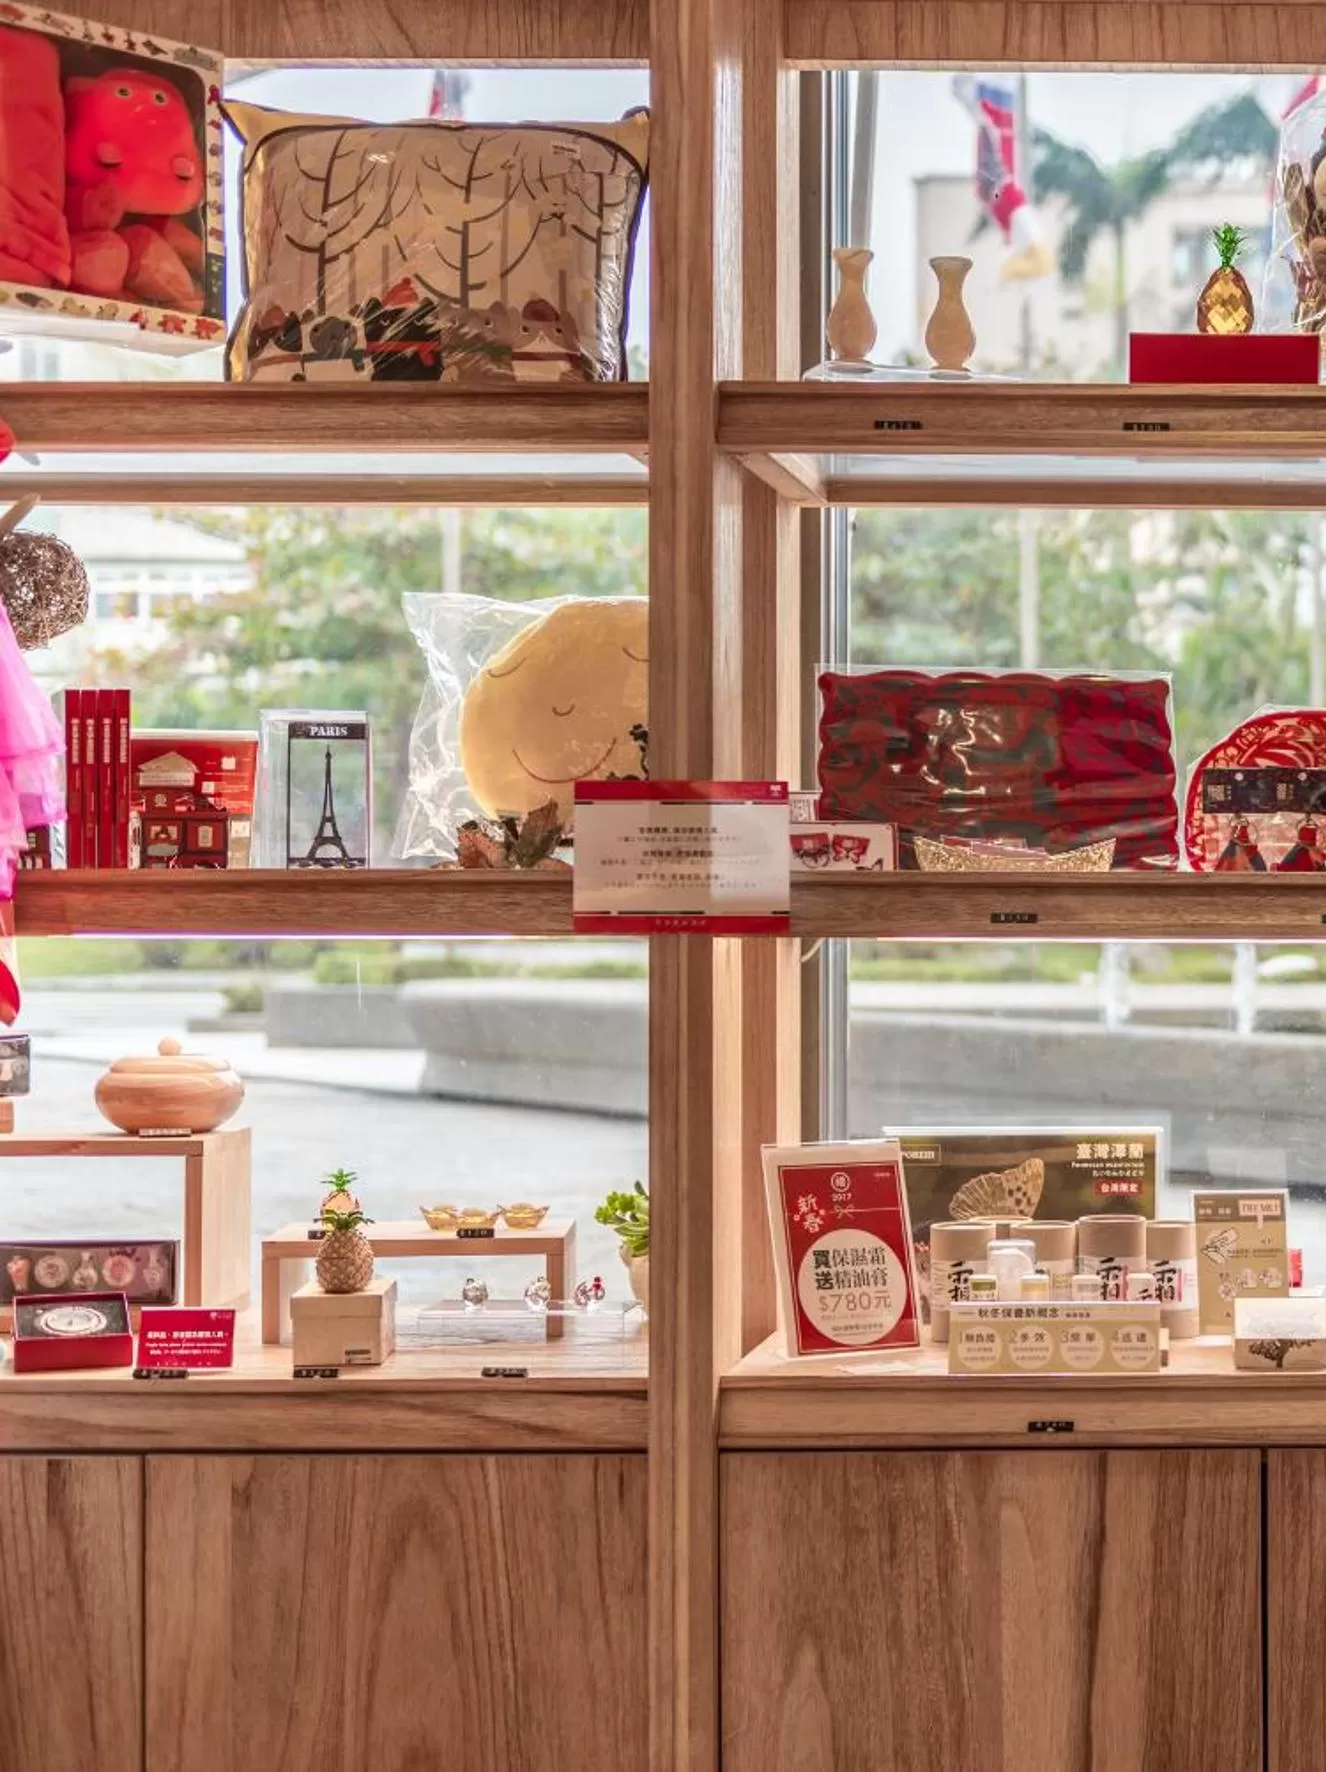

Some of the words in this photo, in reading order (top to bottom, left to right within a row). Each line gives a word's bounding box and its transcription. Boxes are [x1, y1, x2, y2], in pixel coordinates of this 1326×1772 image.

[309, 726, 348, 737] PARIS
[813, 1246, 886, 1270] 買保濕霜
[814, 1267, 888, 1291] 送精油膏
[819, 1290, 892, 1314] $780元
